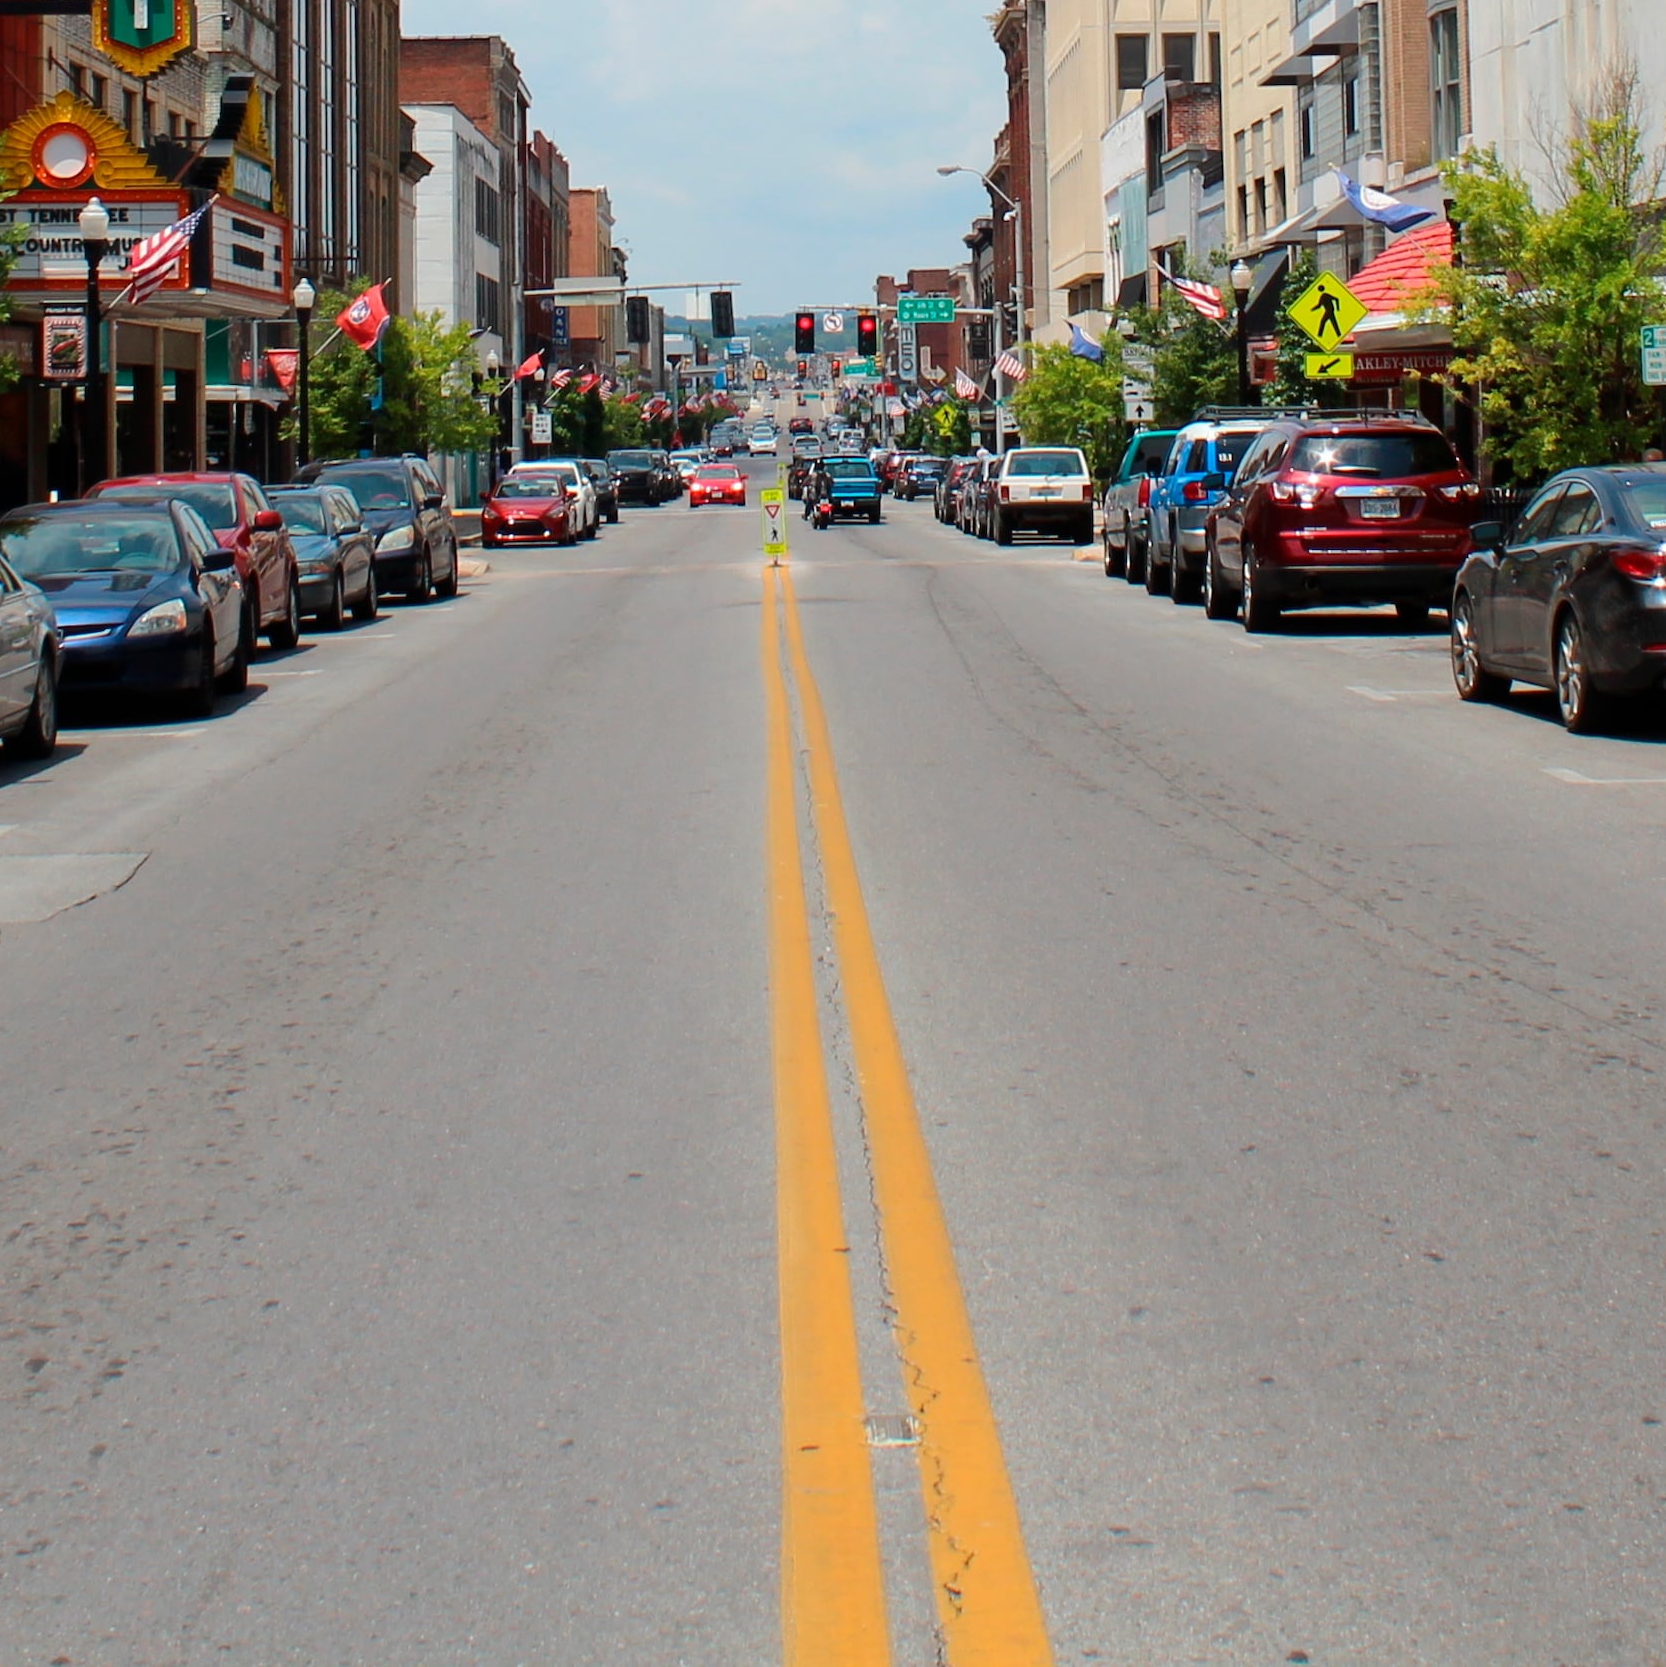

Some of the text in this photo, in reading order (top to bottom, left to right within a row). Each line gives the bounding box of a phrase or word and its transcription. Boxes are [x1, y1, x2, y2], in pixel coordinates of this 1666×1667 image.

[30, 209, 129, 223] TENNEEE
[1643, 329, 1653, 346] 2
[1355, 354, 1453, 371] AKLEY-MITCHE
